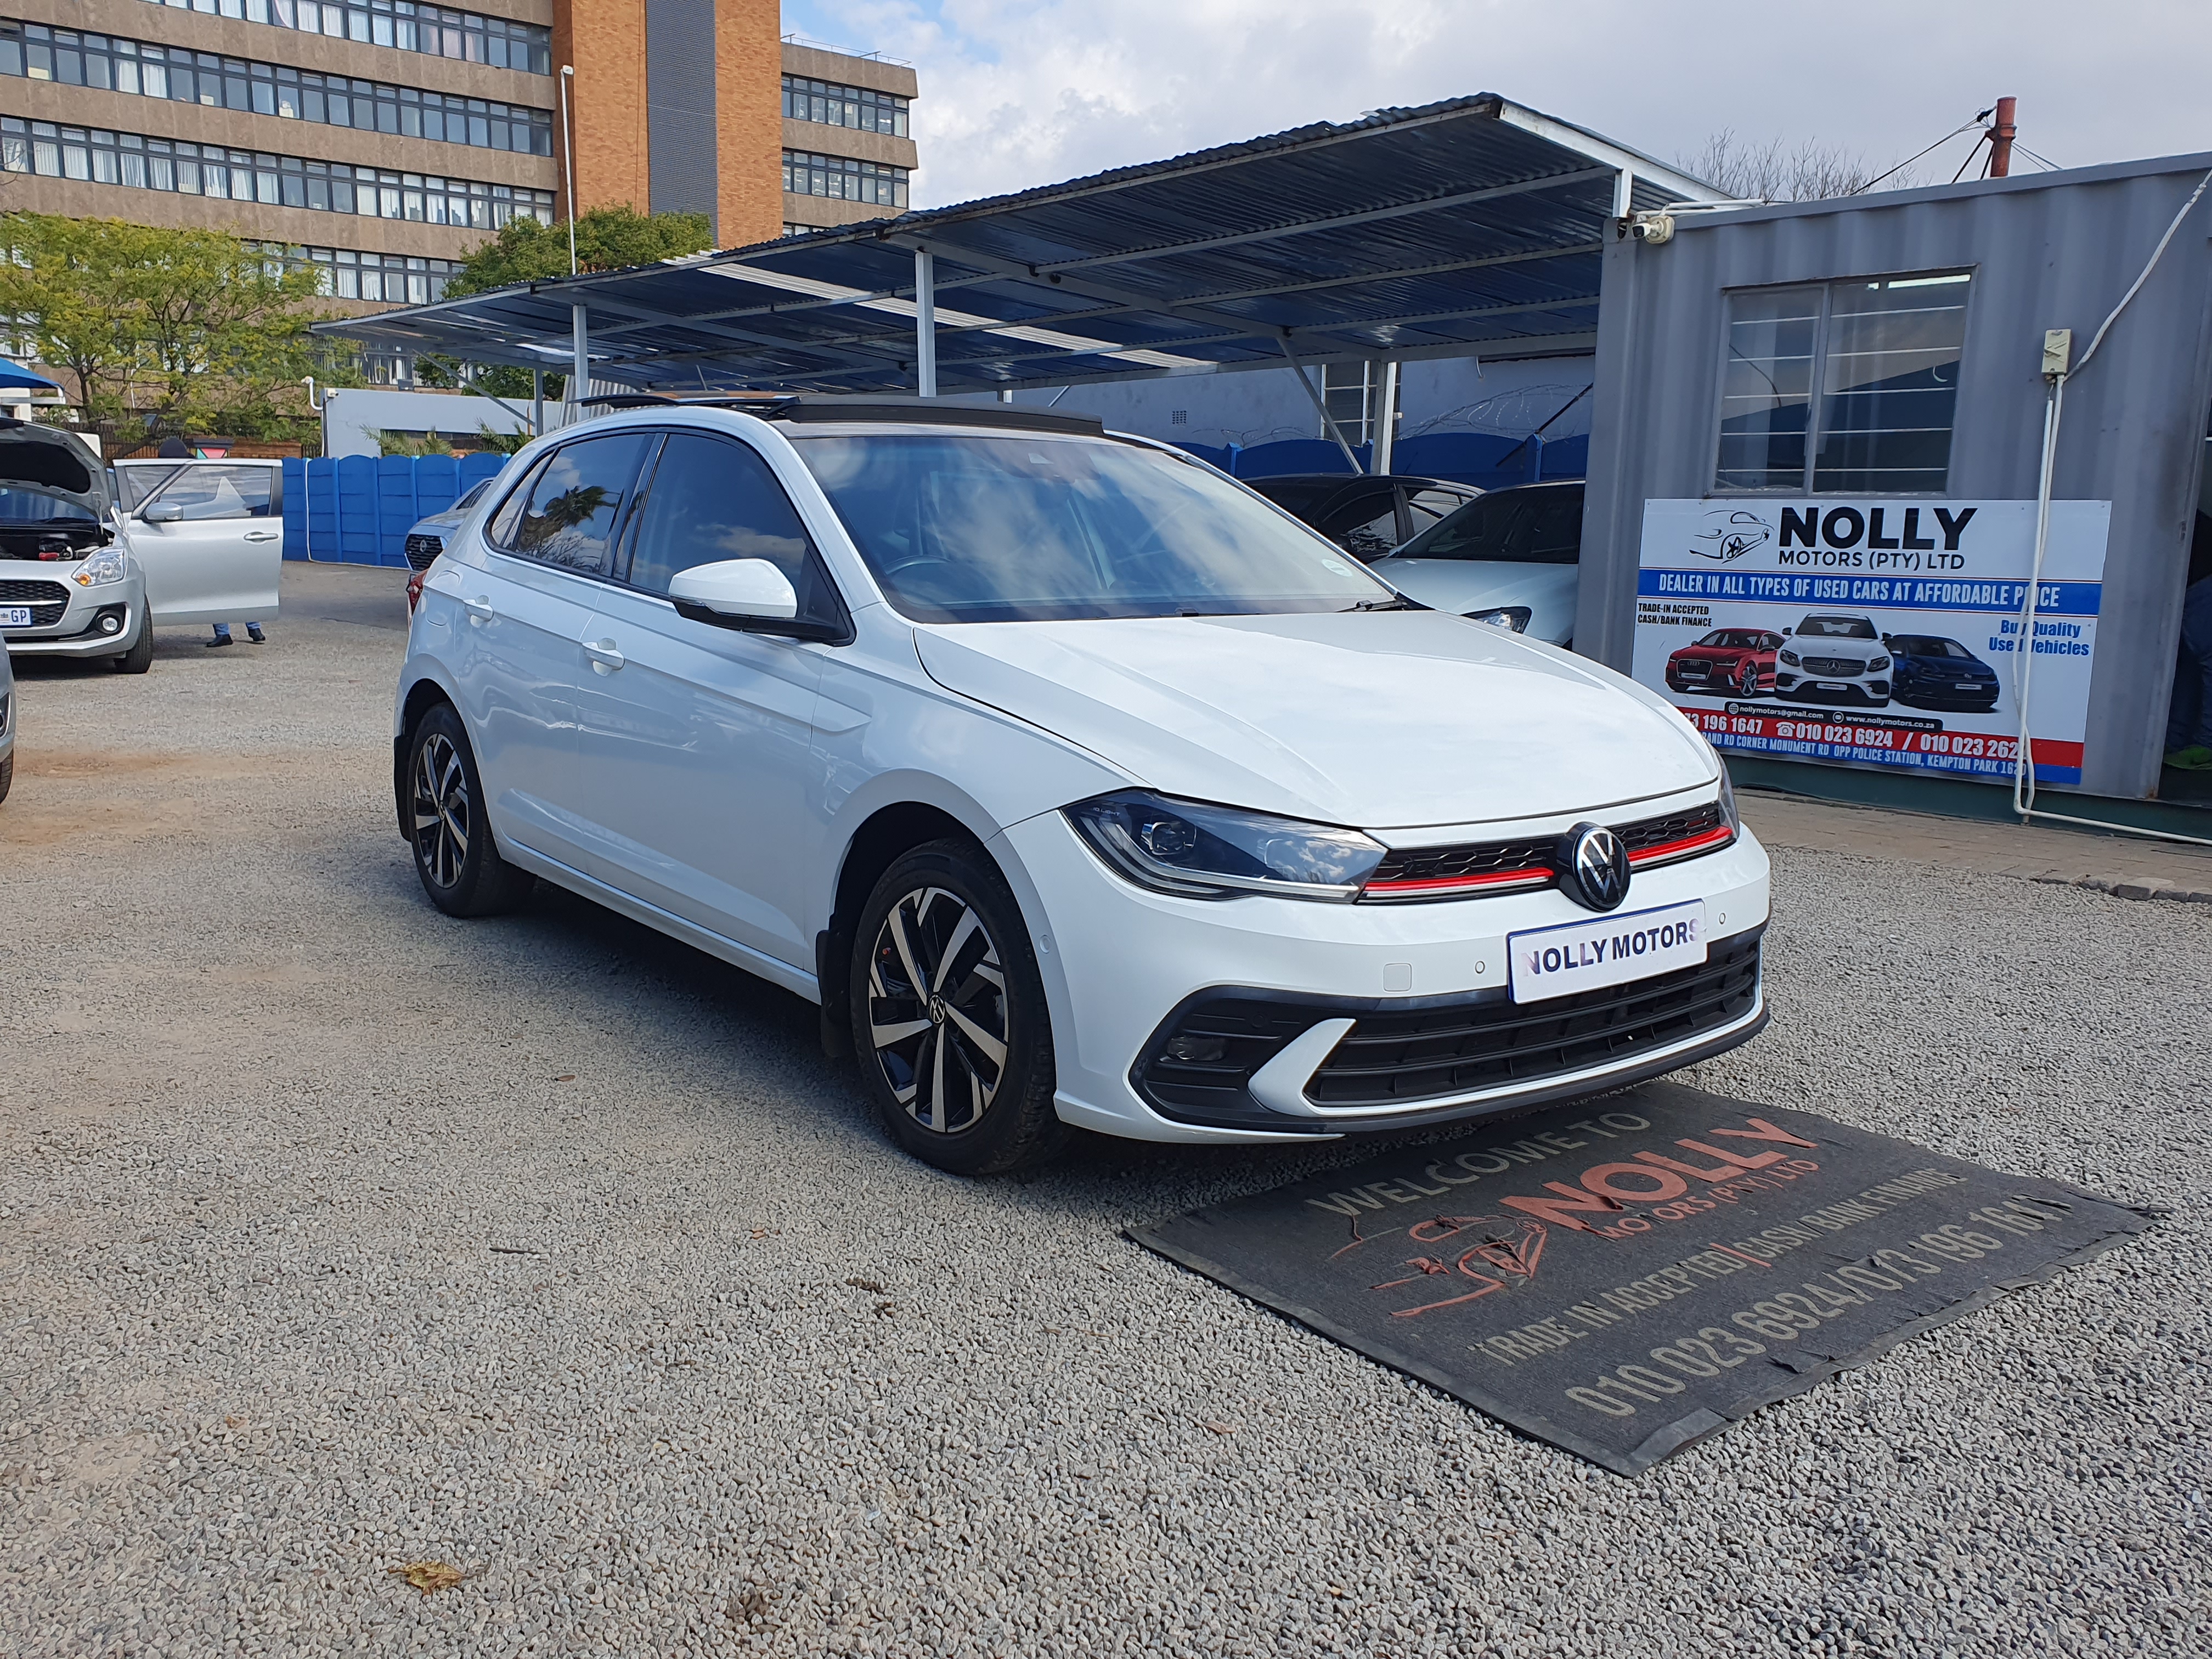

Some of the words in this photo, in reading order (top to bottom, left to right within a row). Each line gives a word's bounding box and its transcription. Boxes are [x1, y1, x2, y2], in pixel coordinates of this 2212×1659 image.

[1779, 506, 1978, 550] NOLLY
[1779, 550, 1863, 567] MOTORS
[1869, 551, 1920, 571] (PTY)
[1927, 553, 1965, 569] LTD
[1659, 574, 1703, 592] DEALER
[1706, 575, 1719, 593] IN
[1723, 577, 1745, 594] ALL
[1750, 577, 1789, 596] TYPES
[1793, 578, 1810, 597] OF
[1814, 579, 1849, 598] USED
[1853, 581, 1889, 600] CARS
[1893, 582, 1911, 601] AT
[1914, 583, 2010, 605] AFFORDABLE
[11, 610, 27, 623] GP
[1638, 603, 1671, 613] TRADE-IN
[1672, 605, 1709, 615] ACCEPTED
[1638, 614, 1680, 625] CASH/BANK
[1681, 617, 1712, 627] FINANCE
[2032, 620, 2081, 638] Quality
[1740, 706, 1824, 719] nollymotors@gmail.com
[1846, 715, 1934, 729] www.nollymotors.co.za
[1703, 714, 1728, 731] 196
[1731, 717, 1763, 734] 1647
[1796, 723, 1821, 740] 010
[1824, 725, 1853, 743] 023
[1855, 728, 1893, 747] 6924
[1901, 732, 1914, 750] /
[1920, 733, 1949, 752] 010
[1952, 737, 1983, 755] 023
[1987, 740, 2026, 759] 262
[1724, 733, 1734, 746] RD
[1736, 735, 1767, 749] CORNER
[1770, 738, 1815, 754] MONUMENT
[1818, 743, 1829, 755] RD
[1833, 744, 1850, 758] OPP
[1853, 747, 1882, 761] POLICE
[1884, 751, 1924, 767] STATION,
[1927, 754, 1971, 770] KEMPTON
[1973, 759, 1999, 773] PARK
[1521, 938, 1607, 977] NOLLY
[1612, 918, 1699, 960] MOTORS
[1304, 1130, 1590, 1216] WELCOME
[1565, 1112, 1651, 1138] TO
[1498, 1117, 1819, 1232] NOLLY
[1765, 1159, 1820, 1180] LTD
[1467, 1316, 1589, 1367] TRADE
[1564, 1300, 1623, 1329] IN
[1565, 1364, 1686, 1417] 010
[1649, 1327, 1767, 1376] 023
[1908, 1223, 2004, 1263] 196
